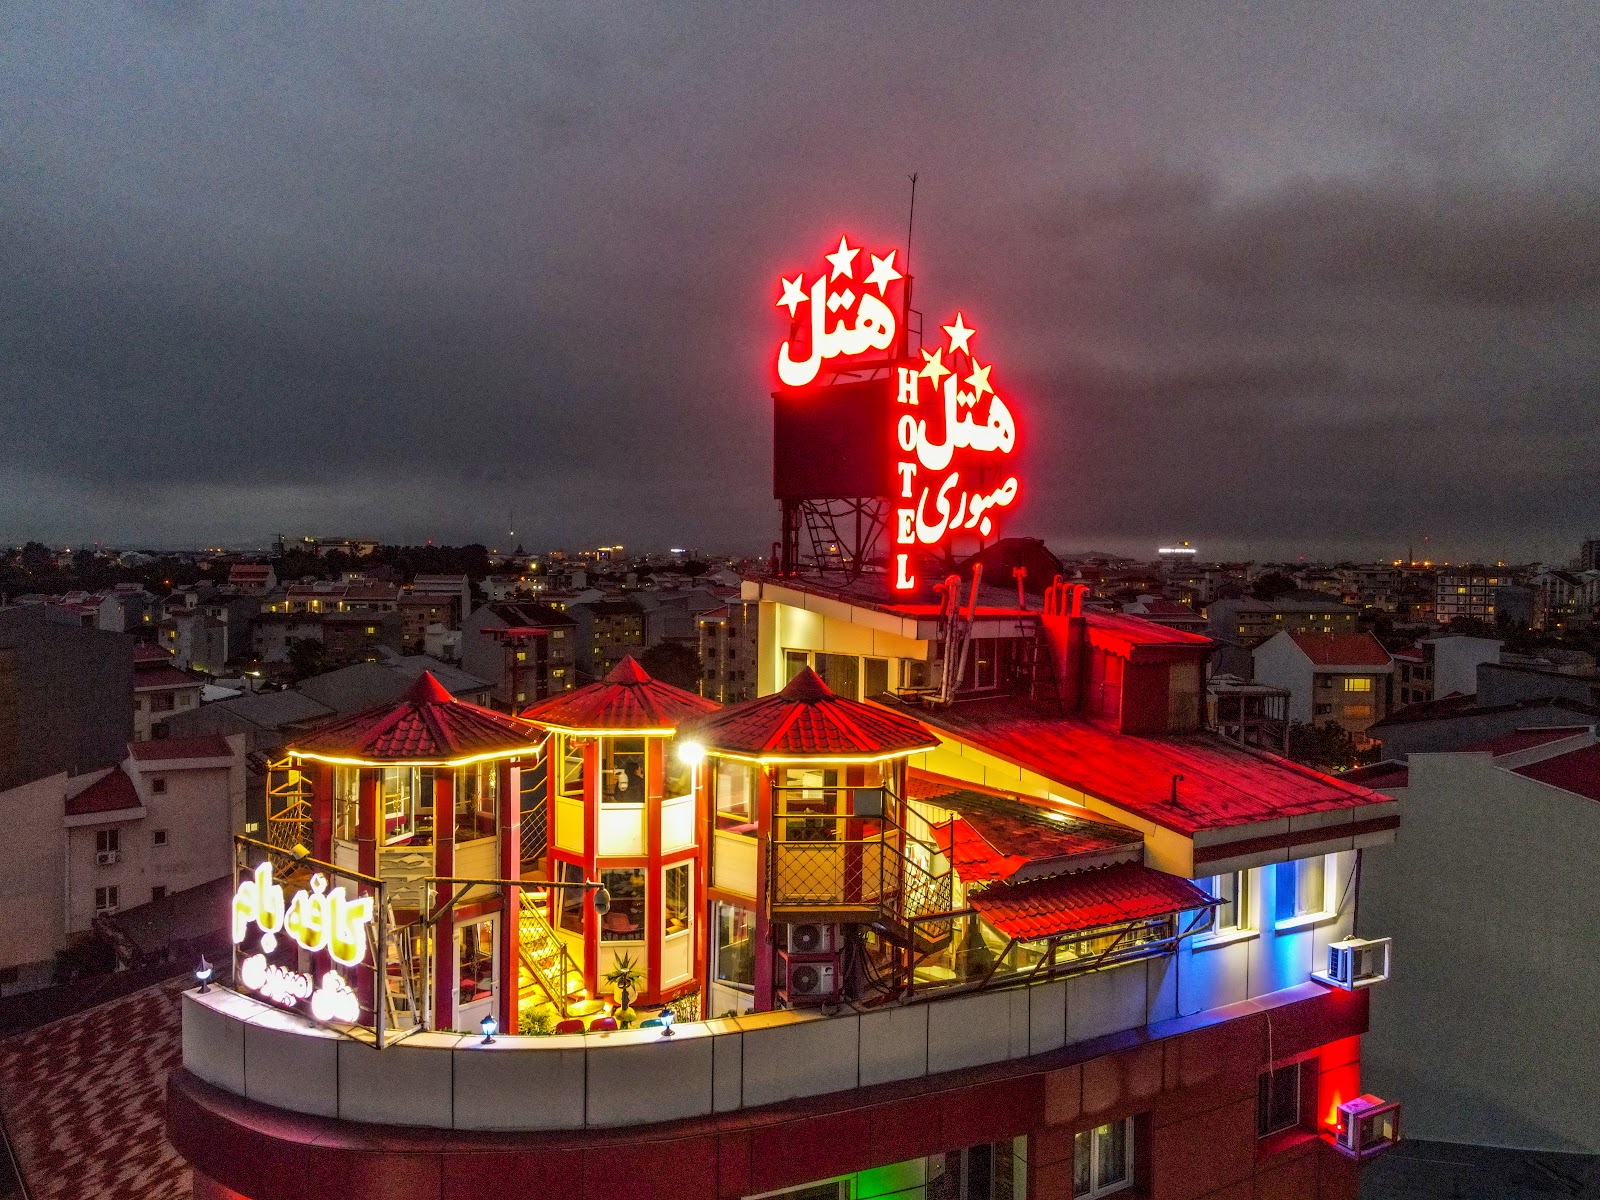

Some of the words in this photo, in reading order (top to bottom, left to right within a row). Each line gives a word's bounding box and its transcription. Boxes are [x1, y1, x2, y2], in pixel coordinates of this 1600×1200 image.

[778, 274, 896, 386] هتل
[916, 373, 1016, 470] هتل
[897, 367, 919, 589] HOTEL
[916, 472, 1018, 544] صبوری
